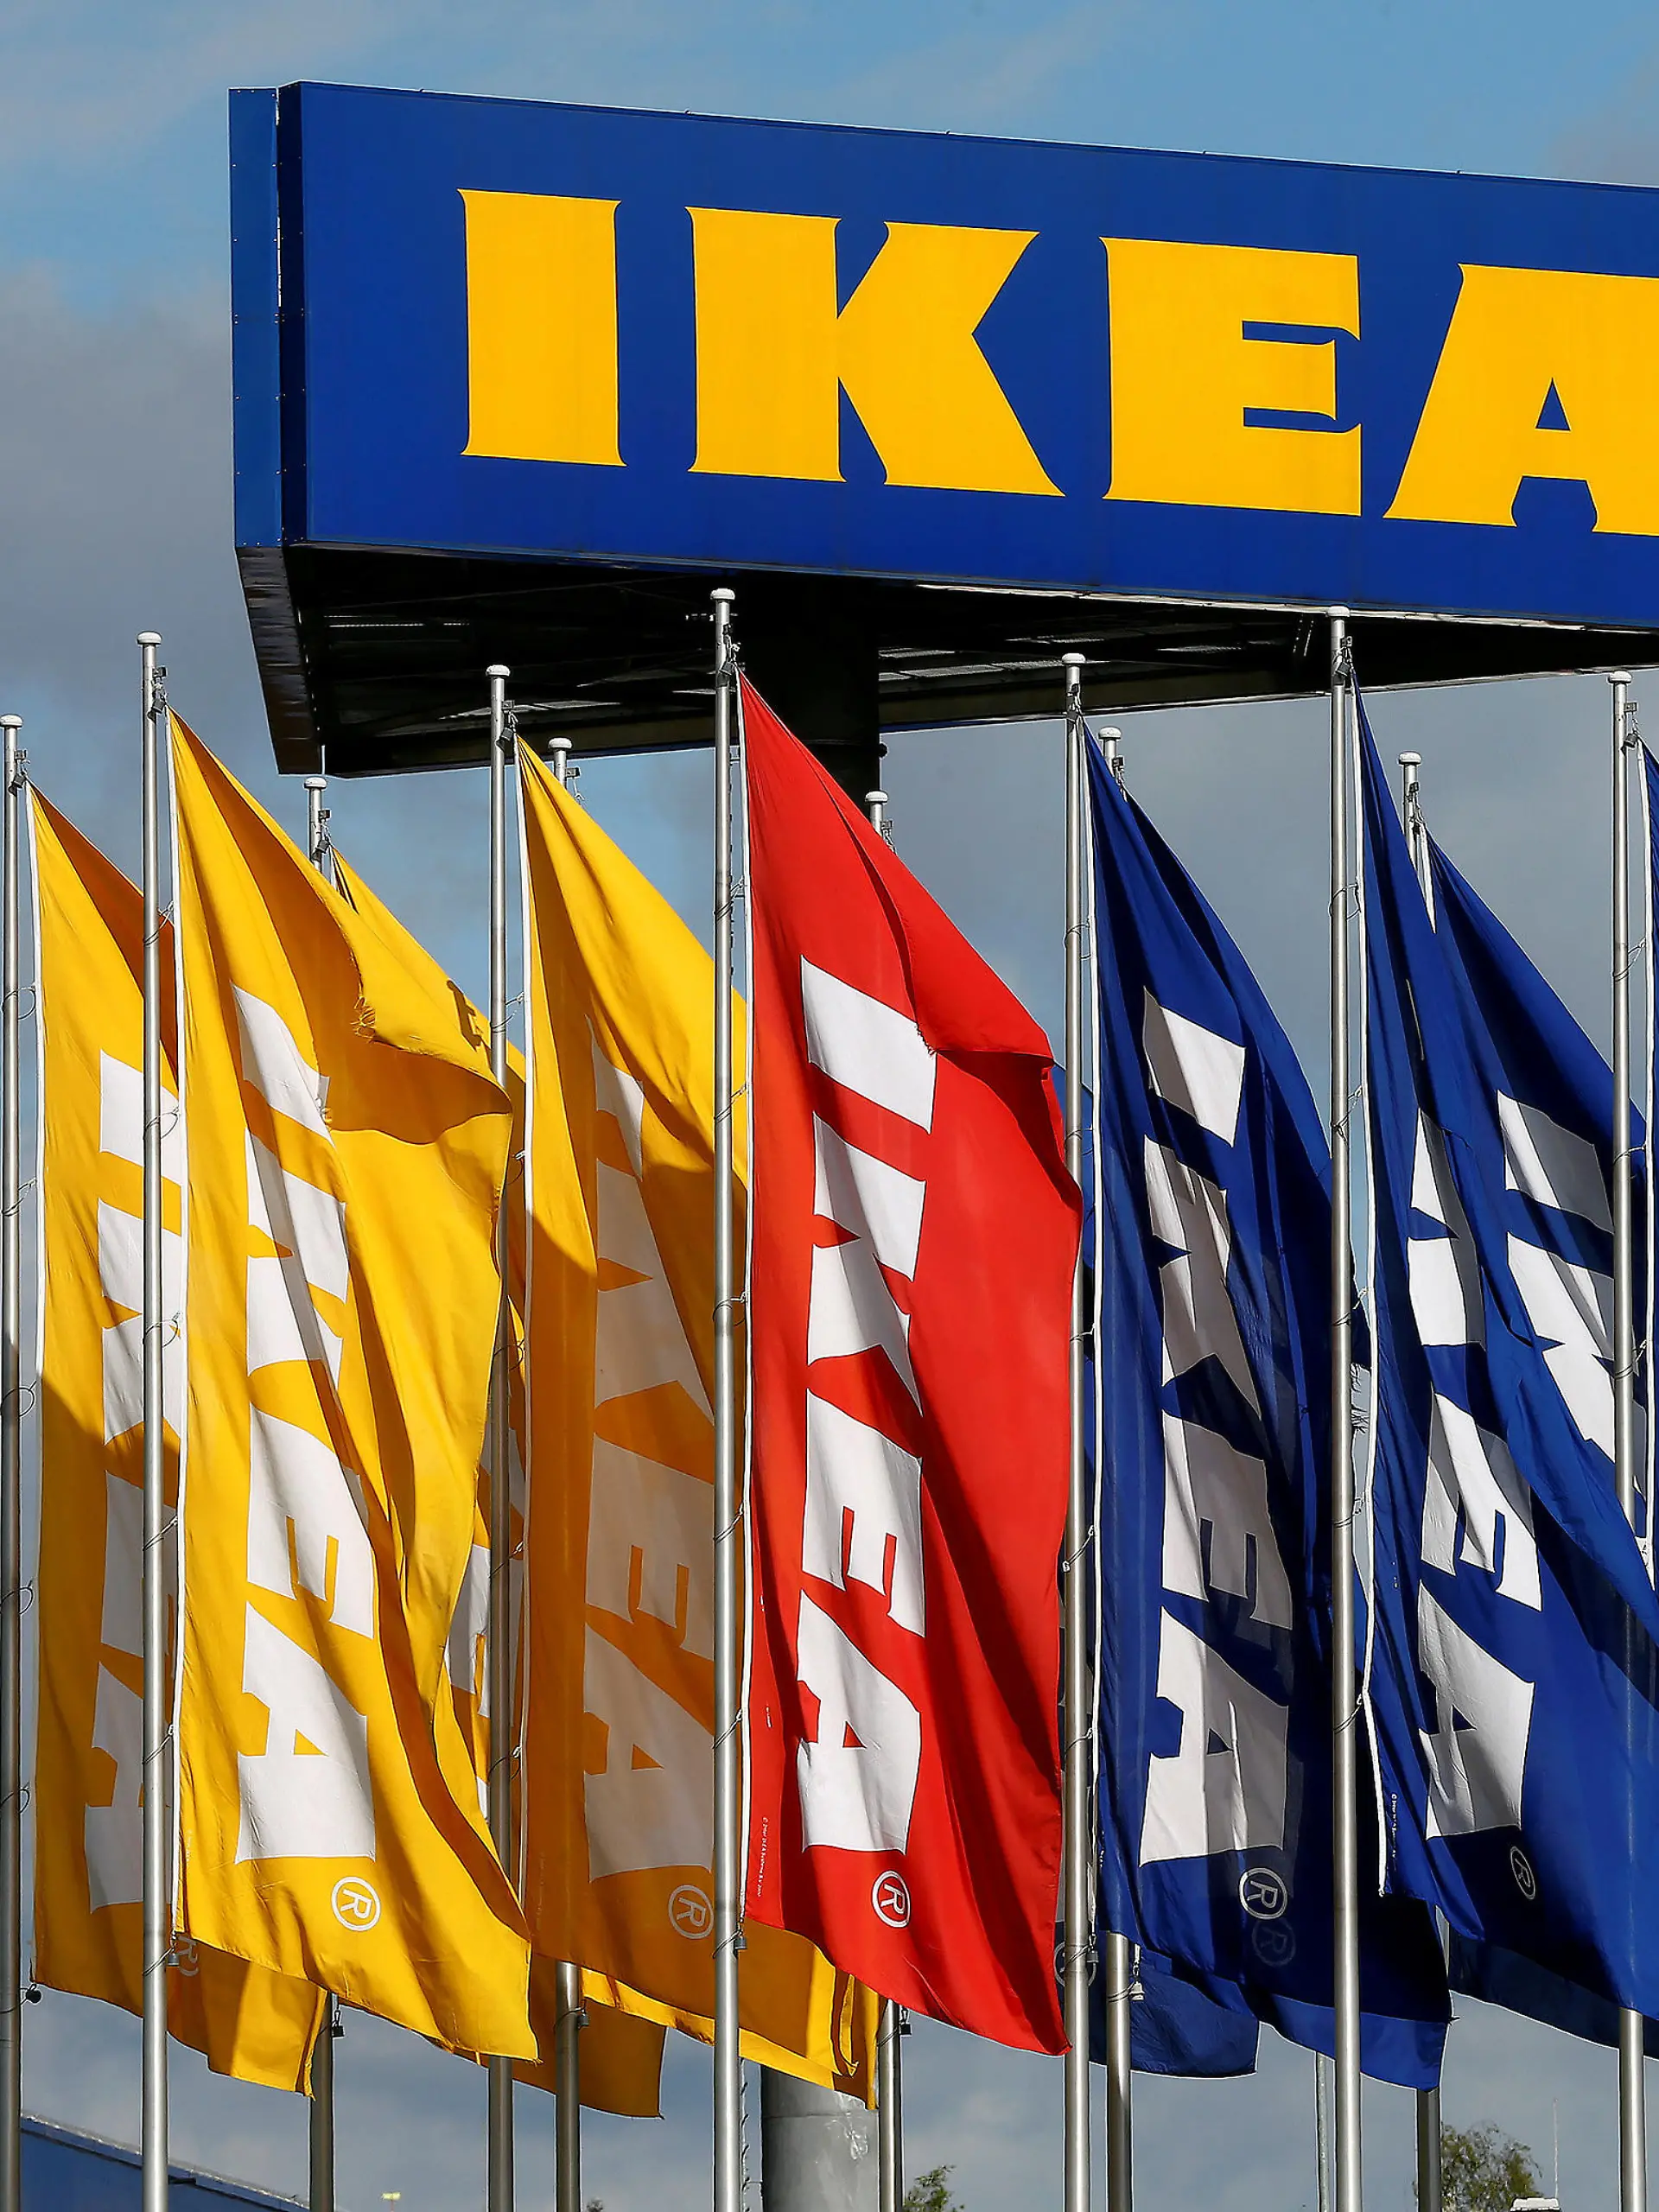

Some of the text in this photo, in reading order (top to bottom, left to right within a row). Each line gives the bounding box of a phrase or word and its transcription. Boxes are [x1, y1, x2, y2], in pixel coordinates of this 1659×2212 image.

[457, 188, 1659, 537] IKEA
[797, 954, 938, 1854] IKEA
[1139, 985, 1294, 1868] IKEA
